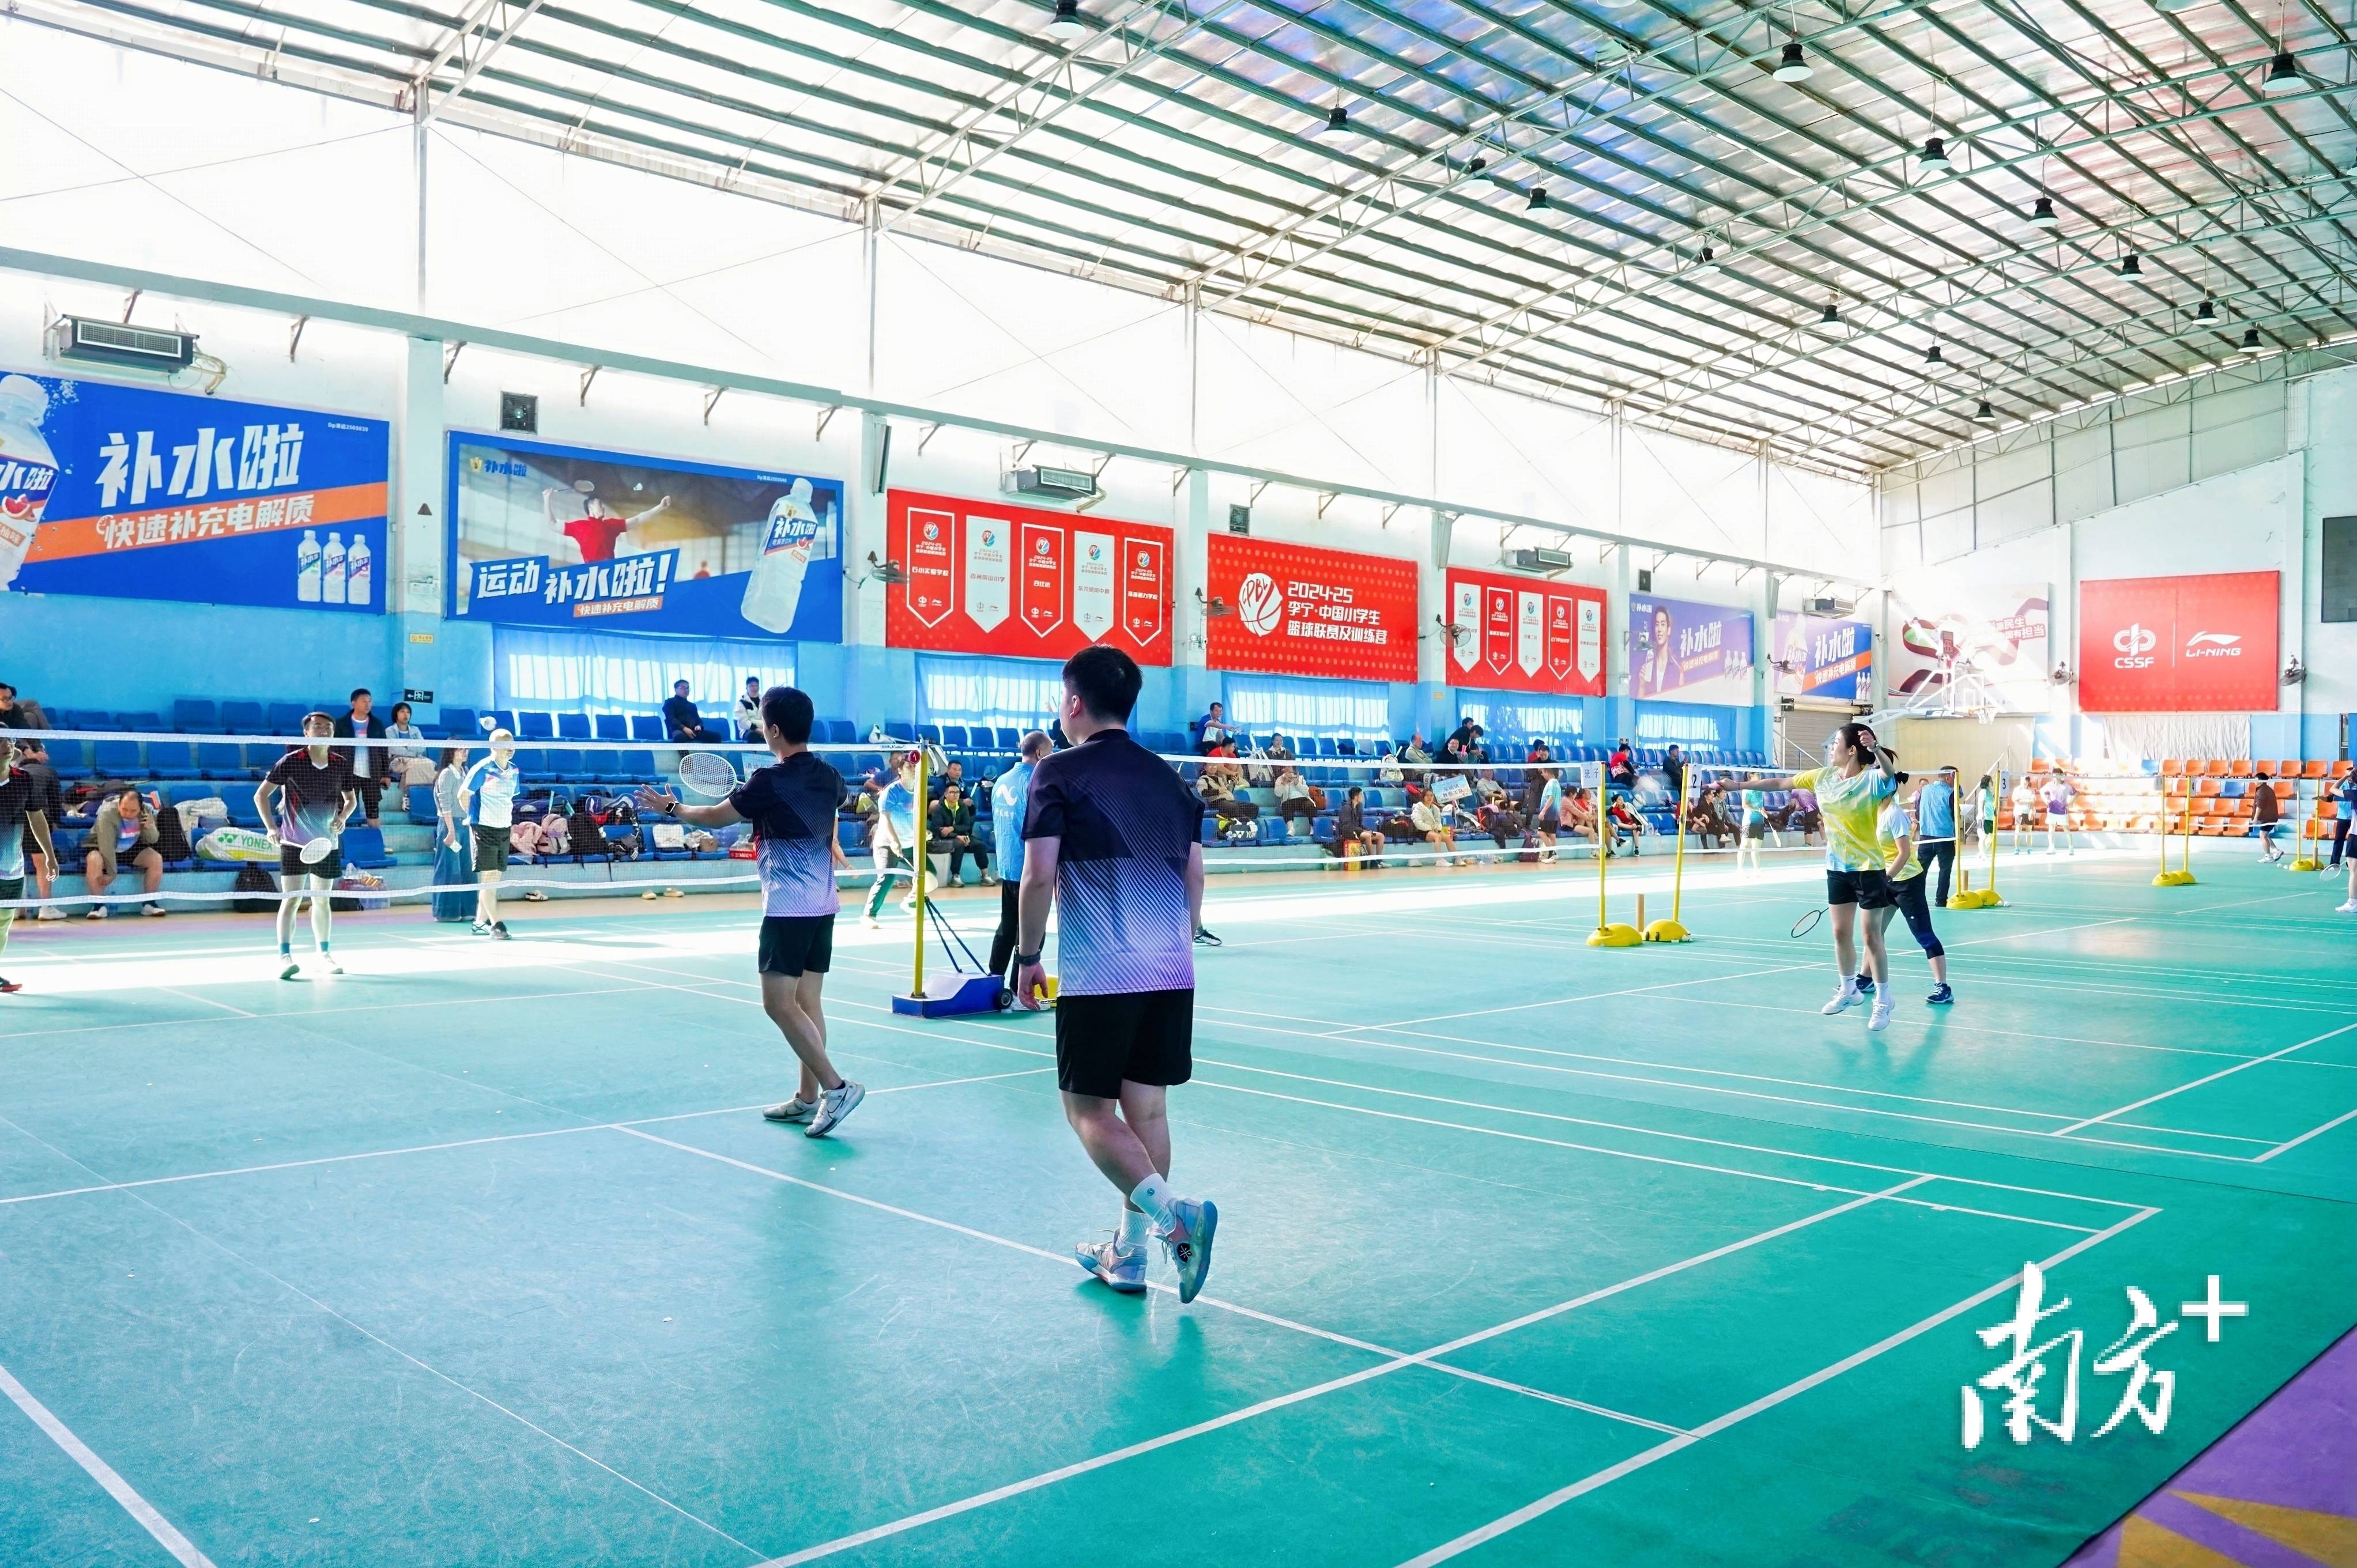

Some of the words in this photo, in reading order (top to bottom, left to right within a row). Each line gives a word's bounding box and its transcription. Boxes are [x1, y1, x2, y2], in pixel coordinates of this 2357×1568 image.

[95, 423, 304, 508] 补水啦
[485, 460, 527, 477] 补水啦
[104, 494, 315, 549] 快速补充电解质
[774, 517, 817, 538] 补水啦
[579, 598, 658, 615] 快速补充电解质
[1287, 619, 1388, 645] 篮球联赛及训练营
[1680, 621, 1722, 658] 补水啦
[1815, 627, 1855, 668] 补水啦
[2186, 648, 2241, 658] LI-NING
[2114, 657, 2154, 668] CSSF
[1692, 774, 1697, 788] 2
[2002, 778, 2007, 789] 3
[242, 836, 272, 851] YONEX
